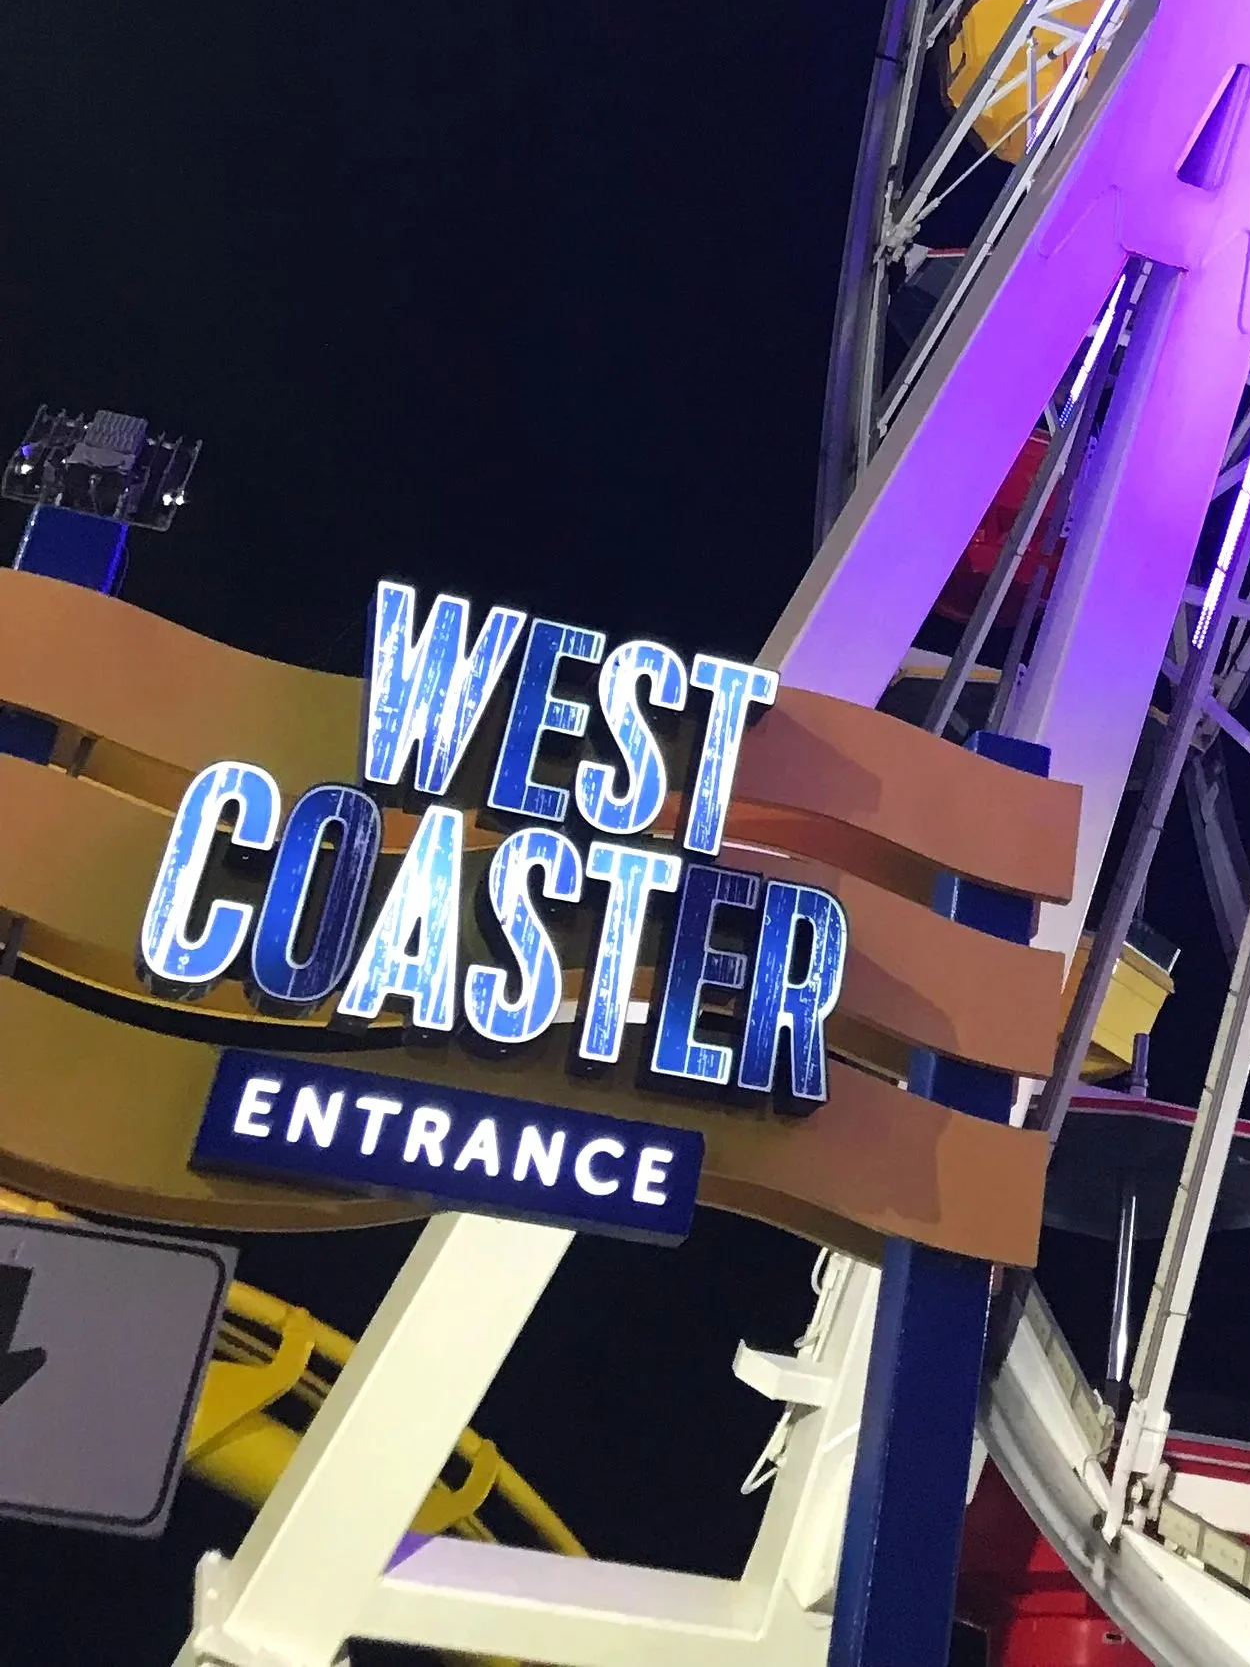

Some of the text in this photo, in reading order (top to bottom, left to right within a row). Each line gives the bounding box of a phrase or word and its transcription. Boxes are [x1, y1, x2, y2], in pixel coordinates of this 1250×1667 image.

[363, 580, 779, 857] WEST
[141, 760, 848, 1102] COASTER
[232, 1078, 675, 1207] ENTRANCE
